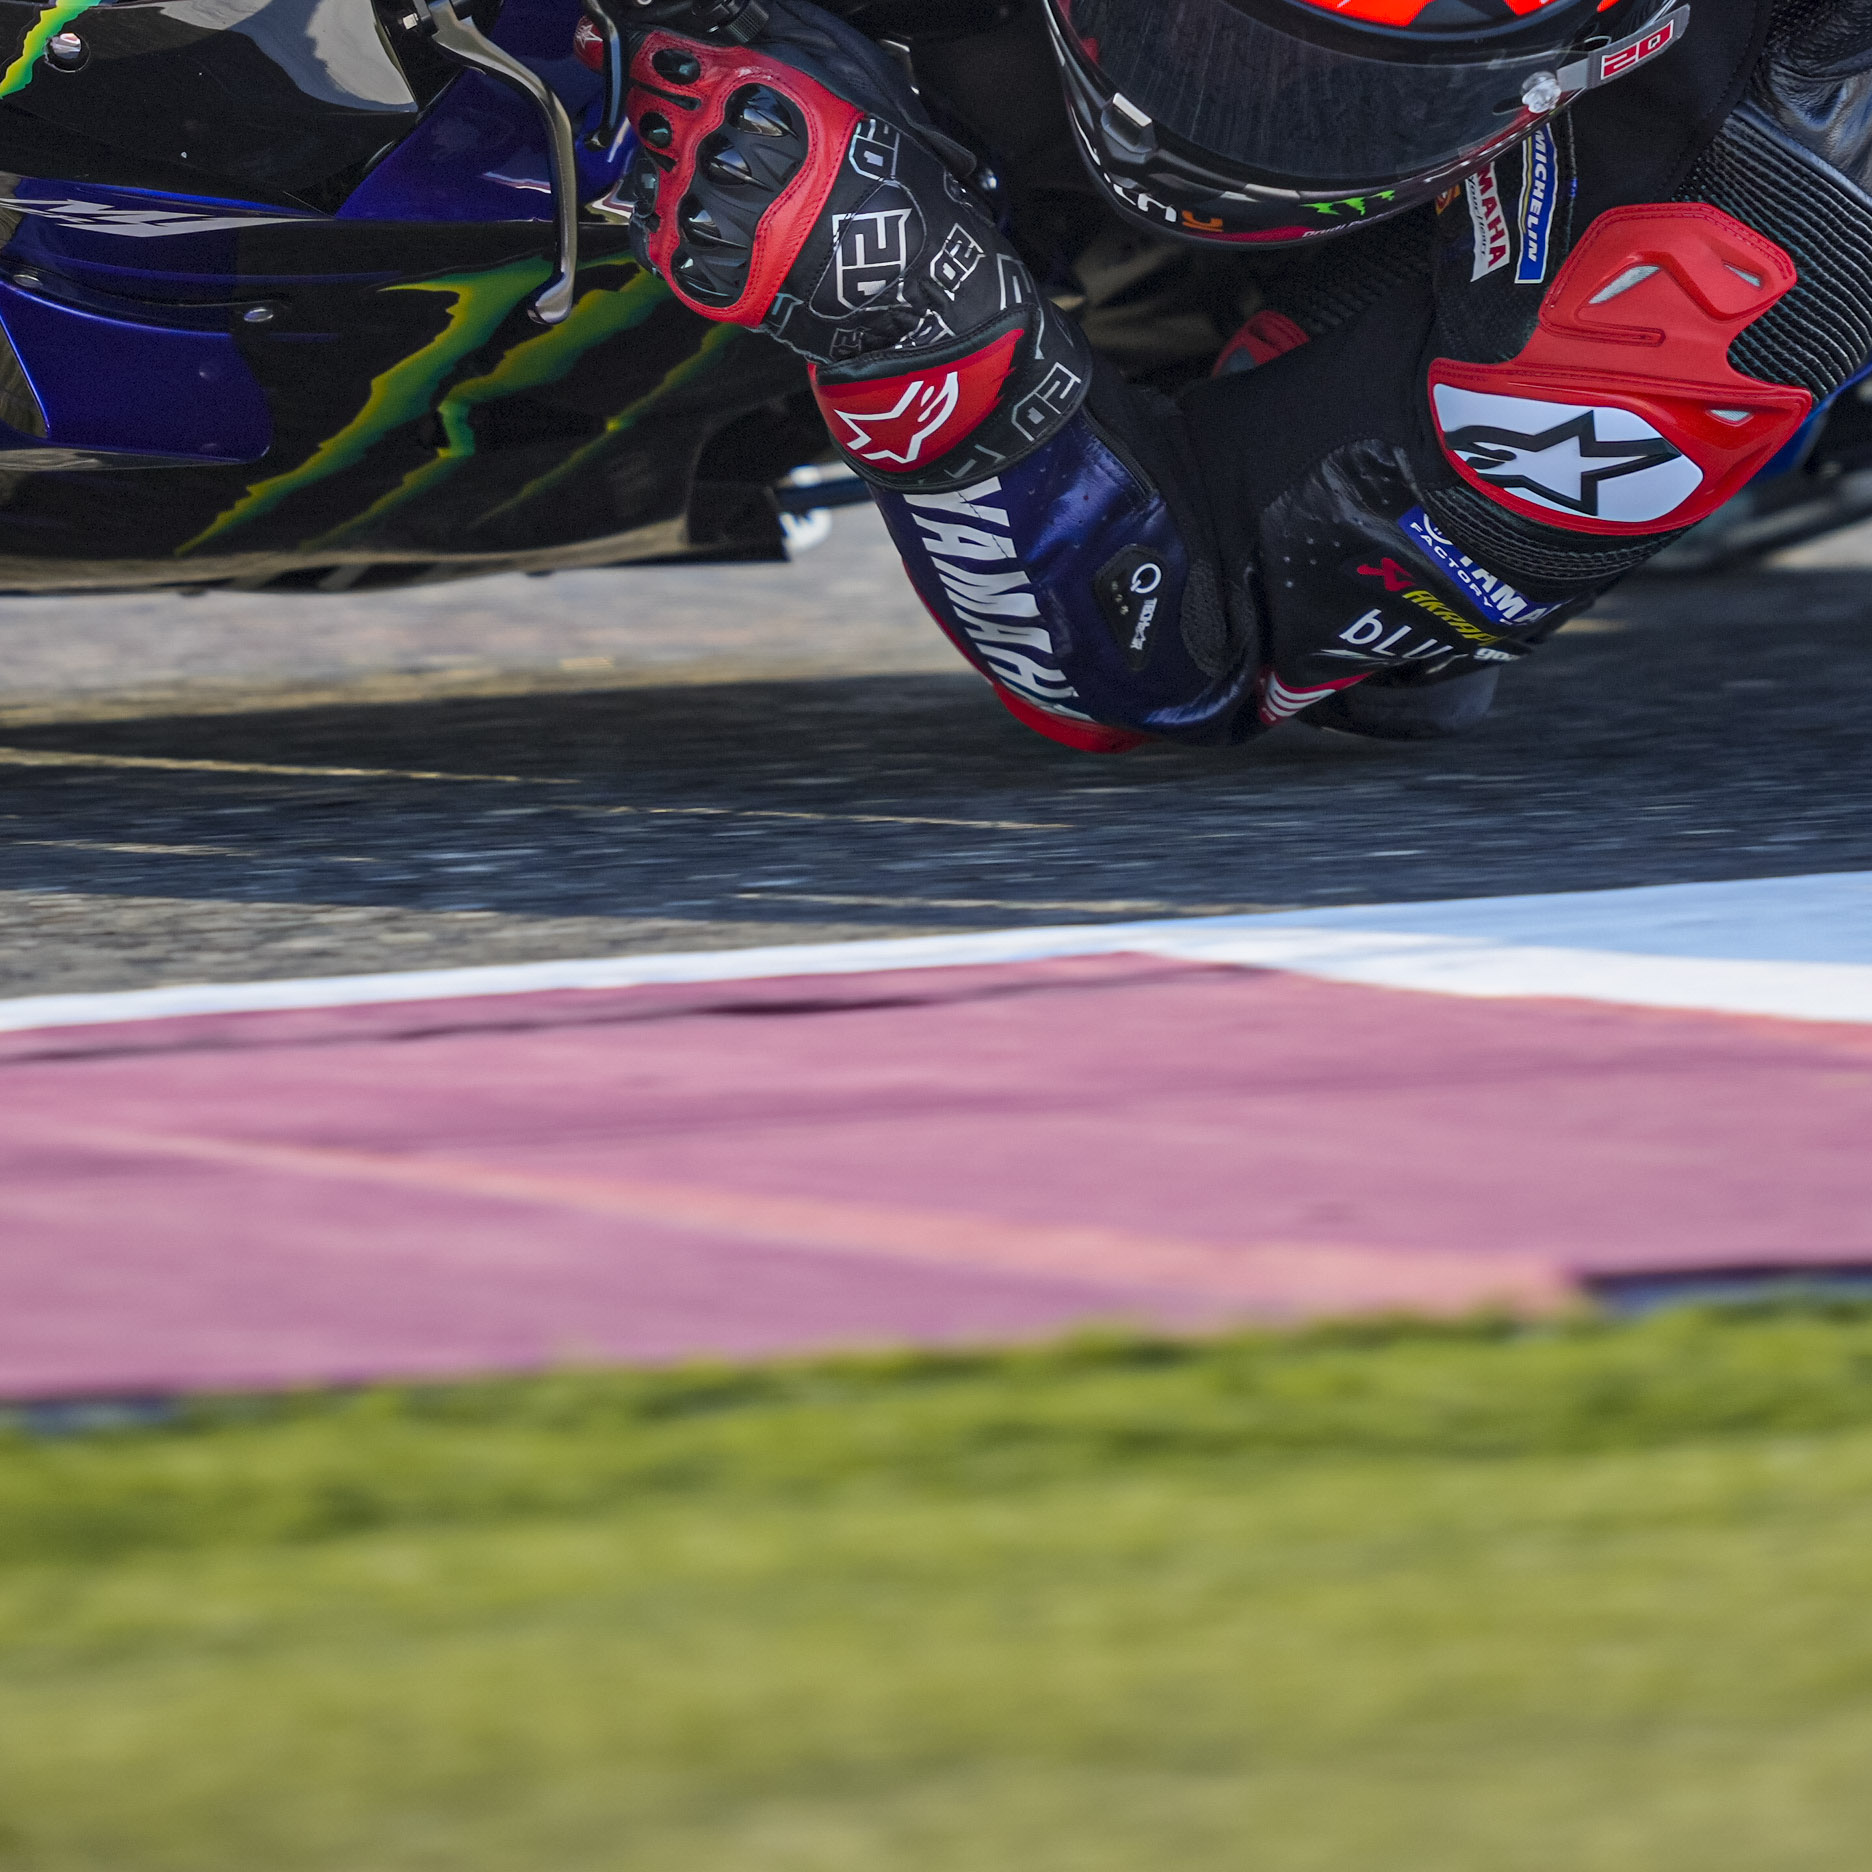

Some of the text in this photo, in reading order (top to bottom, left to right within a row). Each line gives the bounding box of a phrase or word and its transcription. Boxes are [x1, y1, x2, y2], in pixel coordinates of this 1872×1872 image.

[1600, 19, 1674, 80] 20
[1527, 128, 1550, 262] MICHELIN
[832, 207, 913, 312] 20
[930, 223, 986, 300] 20
[1012, 362, 1081, 441] 20
[1410, 521, 1495, 609] FACTORY
